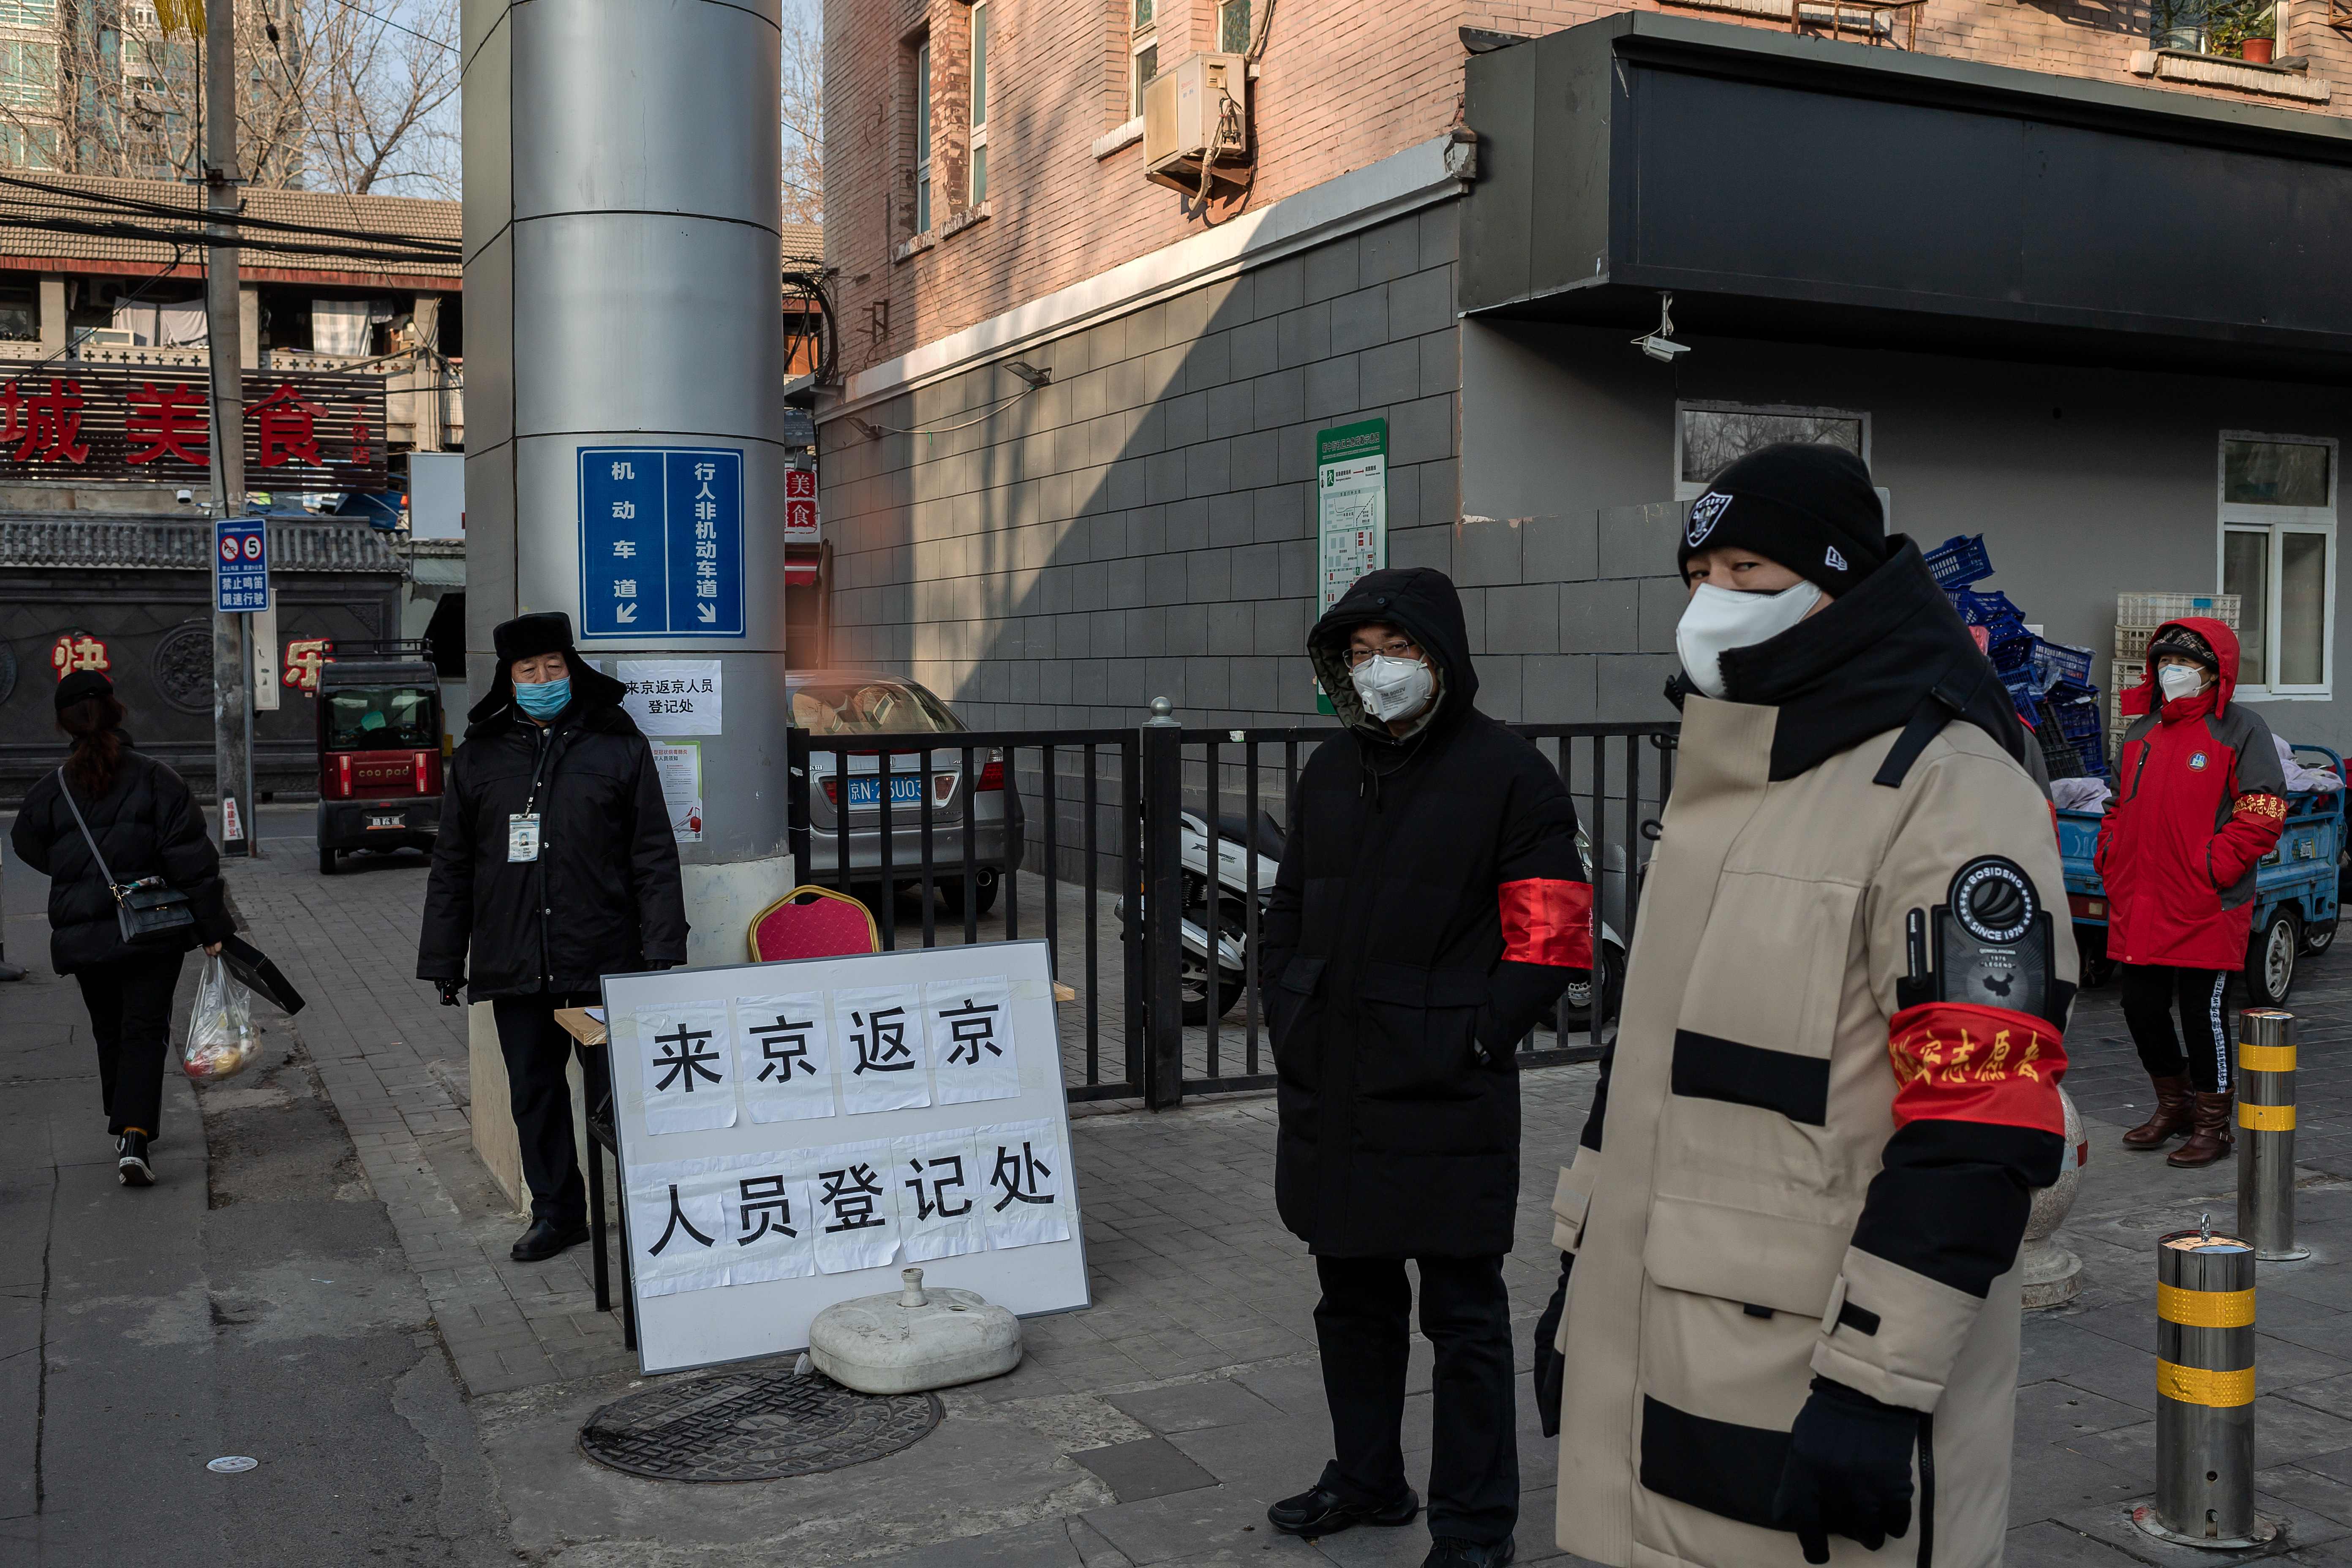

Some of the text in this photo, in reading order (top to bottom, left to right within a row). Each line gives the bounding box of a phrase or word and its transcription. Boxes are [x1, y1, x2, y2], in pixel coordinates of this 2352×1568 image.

[791, 474, 810, 524] 美食
[612, 462, 637, 597] 机动车道
[694, 463, 717, 597] 行人非机动车道
[248, 540, 258, 555] 5
[221, 575, 264, 591] 禁止鸣笛
[222, 591, 264, 606] 限速行驶
[625, 679, 714, 695] 来京返京人员
[648, 699, 694, 714] 登记处
[386, 765, 409, 778] pad
[1970, 921, 2024, 941] SINCE 1976
[653, 999, 1002, 1092] 来京返京
[648, 1141, 1055, 1257] 人员登记处
